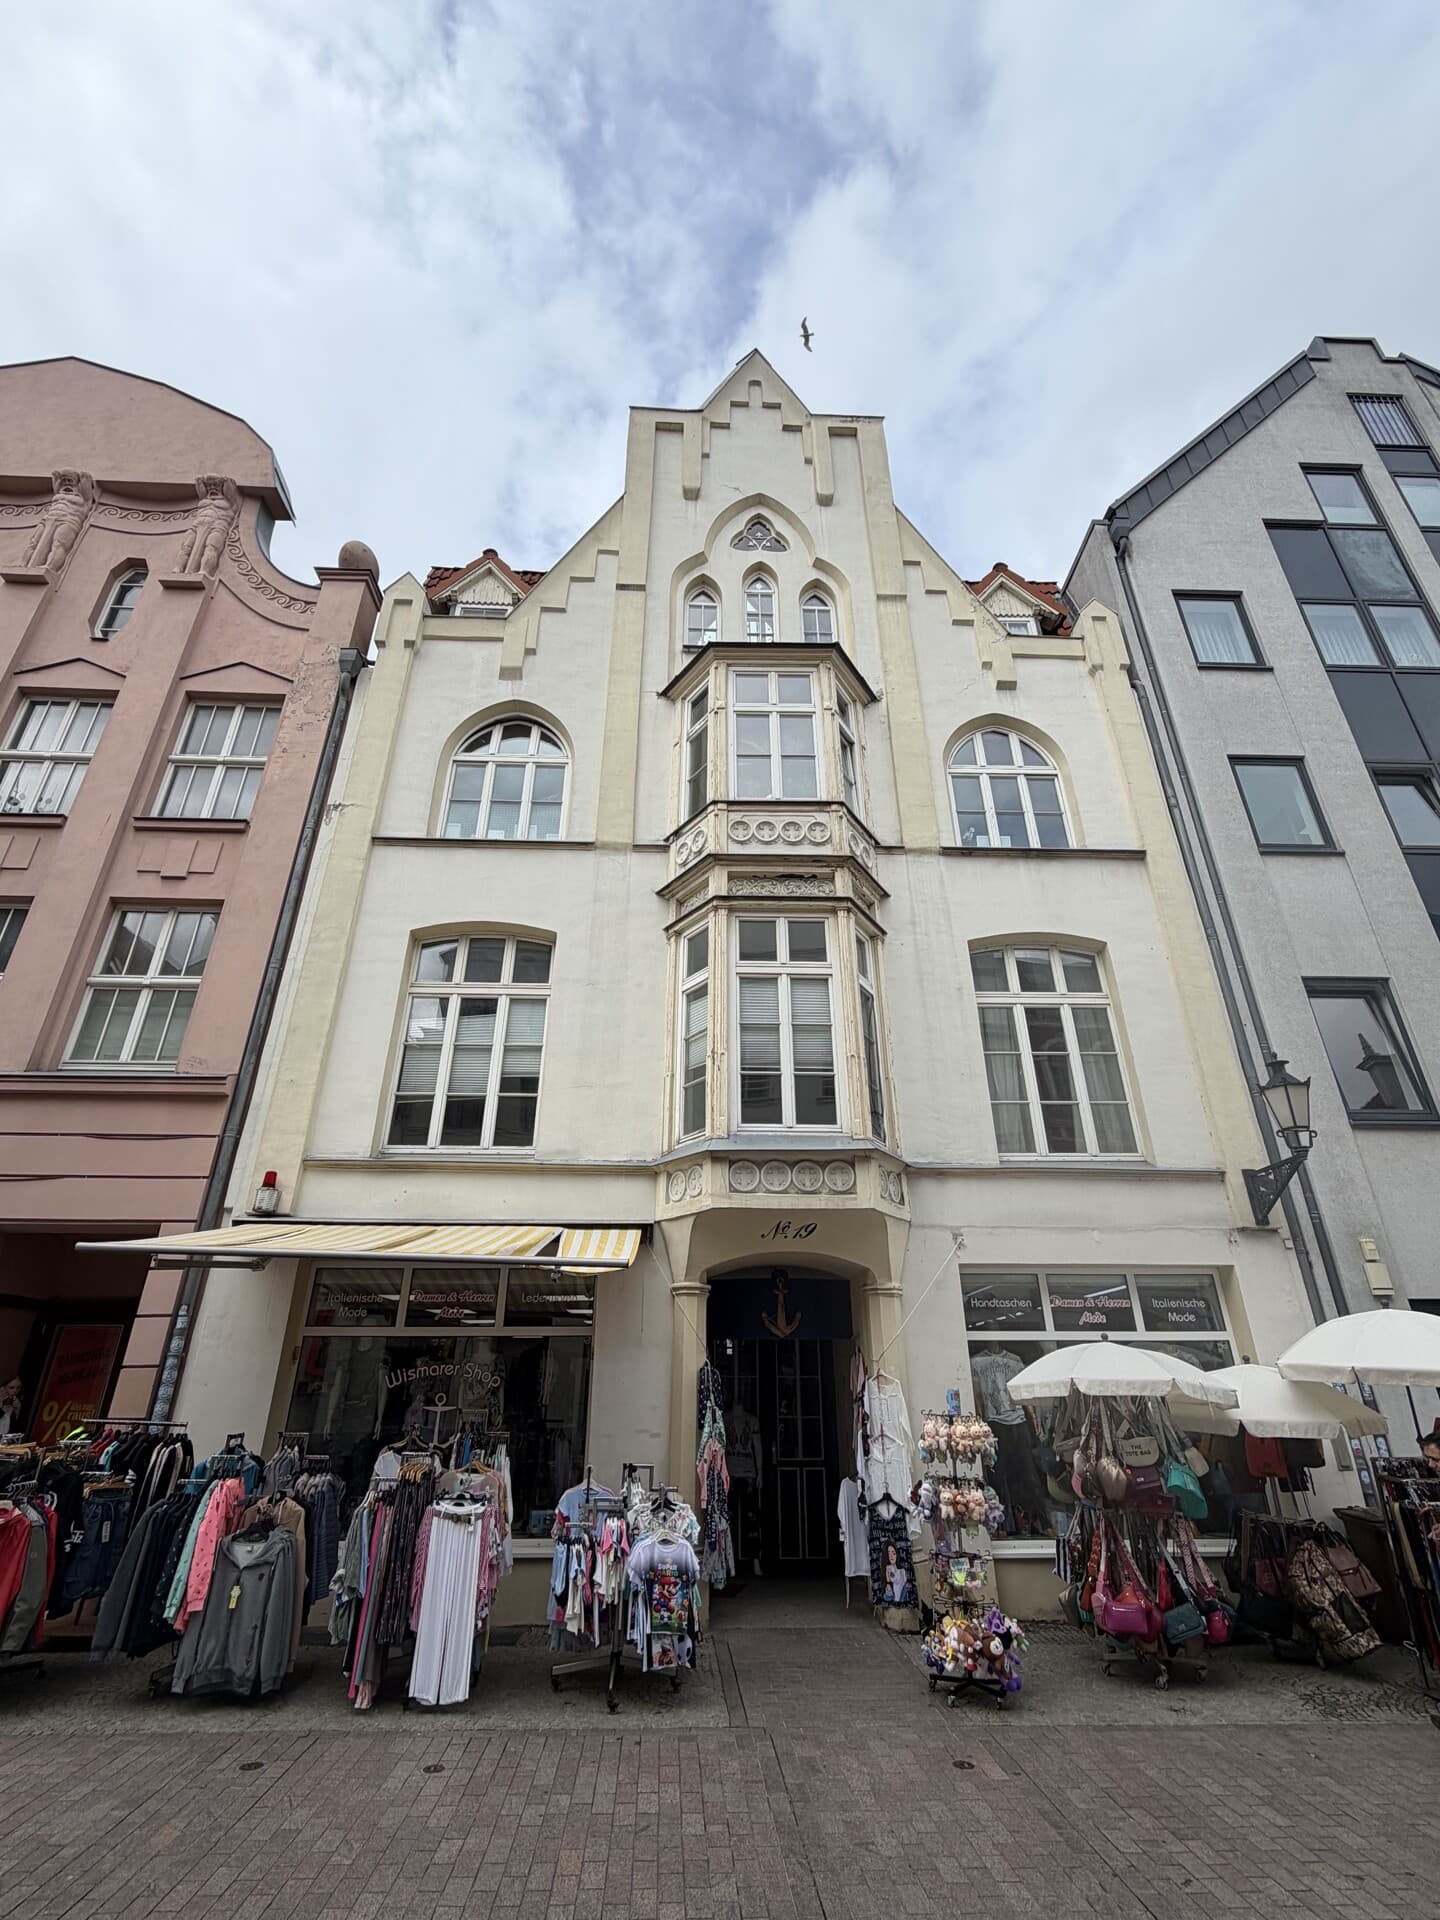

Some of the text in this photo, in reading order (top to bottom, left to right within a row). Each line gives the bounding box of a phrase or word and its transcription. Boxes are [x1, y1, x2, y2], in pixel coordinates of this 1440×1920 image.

[792, 1222, 818, 1239] 19
[327, 1292, 383, 1304] Italienische
[412, 1290, 497, 1304] Damen & Herren
[970, 1298, 1033, 1309] Handtaschen
[1050, 1294, 1131, 1308] Damen & Herren
[1151, 1297, 1206, 1308] Italienische
[338, 1306, 368, 1318] Mode
[1079, 1311, 1107, 1326] Mode
[1167, 1311, 1197, 1323] Mode
[385, 1362, 501, 1389] Wismarer Shop
